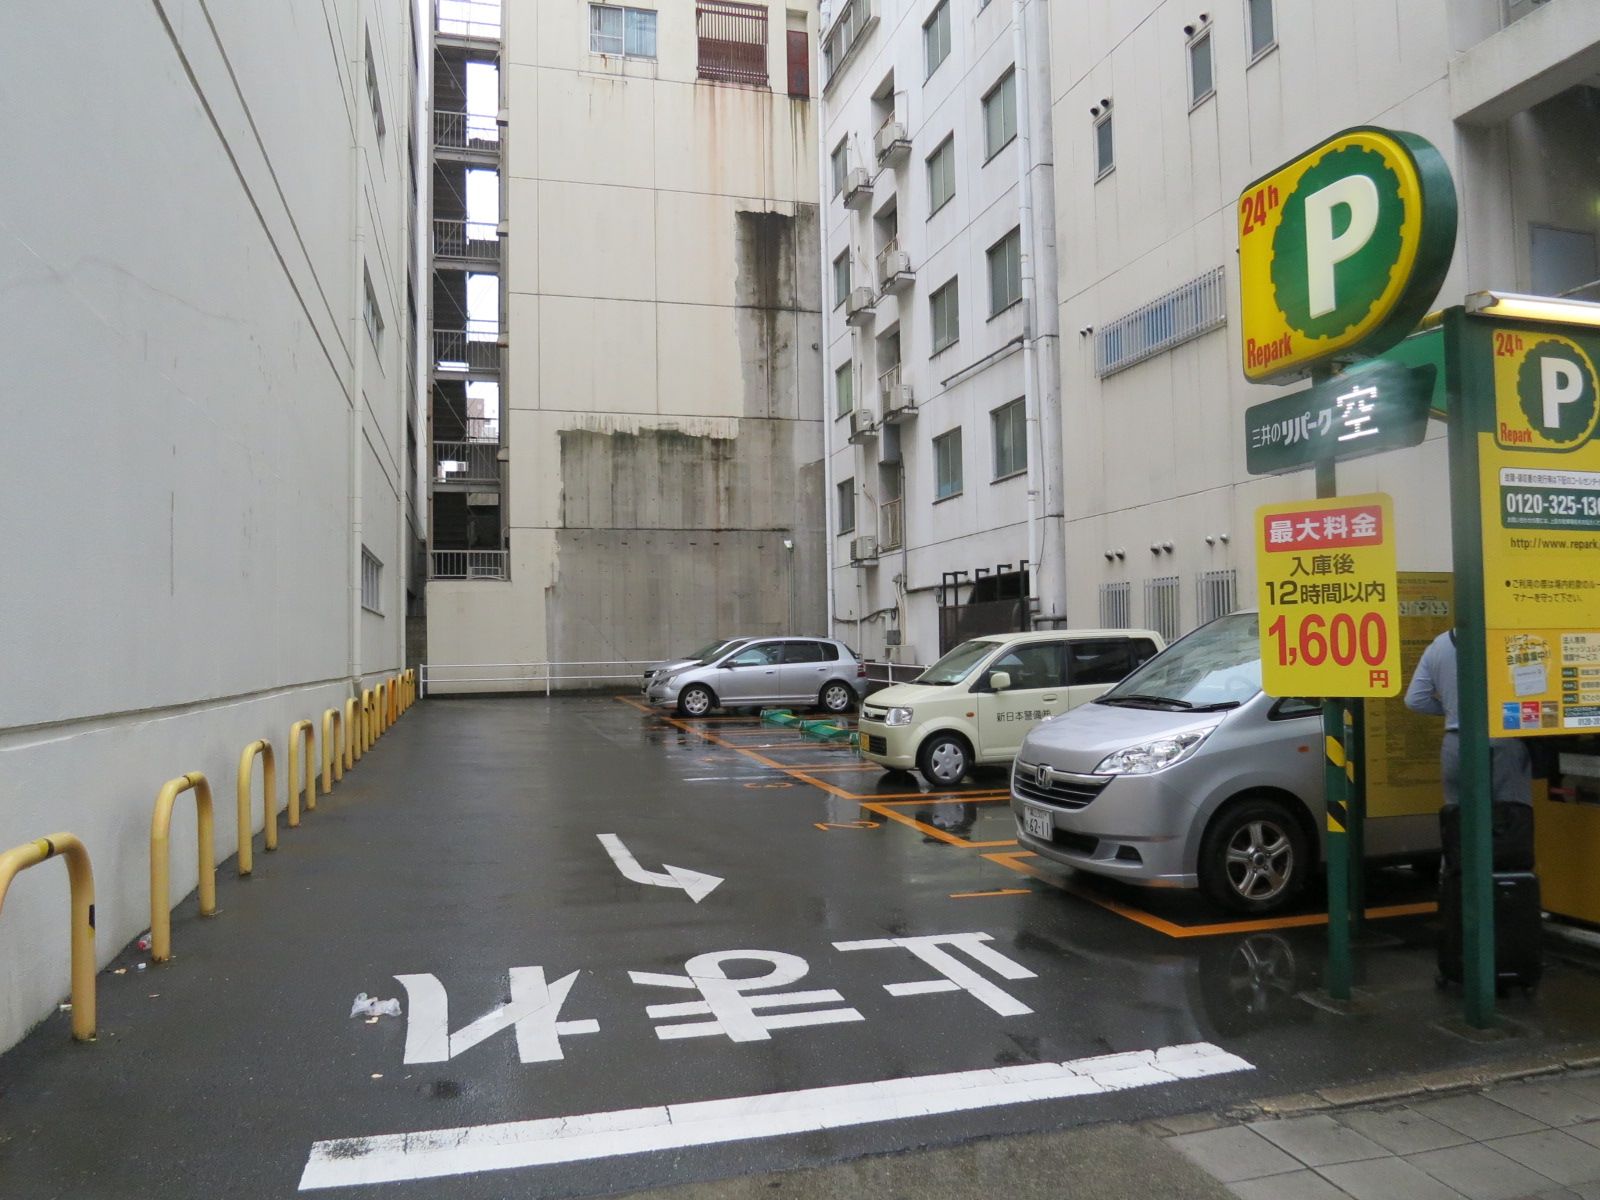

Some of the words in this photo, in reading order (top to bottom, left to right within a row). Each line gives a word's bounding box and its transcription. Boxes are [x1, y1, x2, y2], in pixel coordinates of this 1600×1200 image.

[1242, 185, 1279, 235] 24h
[1305, 175, 1379, 319] P
[1247, 333, 1292, 369] Repark
[1496, 332, 1523, 357] 24h
[1541, 357, 1583, 428] P
[1252, 408, 1332, 448] 三井のリパーク
[1336, 385, 1379, 441] 空
[1501, 422, 1532, 444] Repark
[1270, 513, 1377, 543] 最大料金
[1290, 553, 1355, 577] 入庫後
[1265, 579, 1385, 606] 12時間以内
[1269, 612, 1387, 667] 1,600
[1369, 670, 1389, 688] 円
